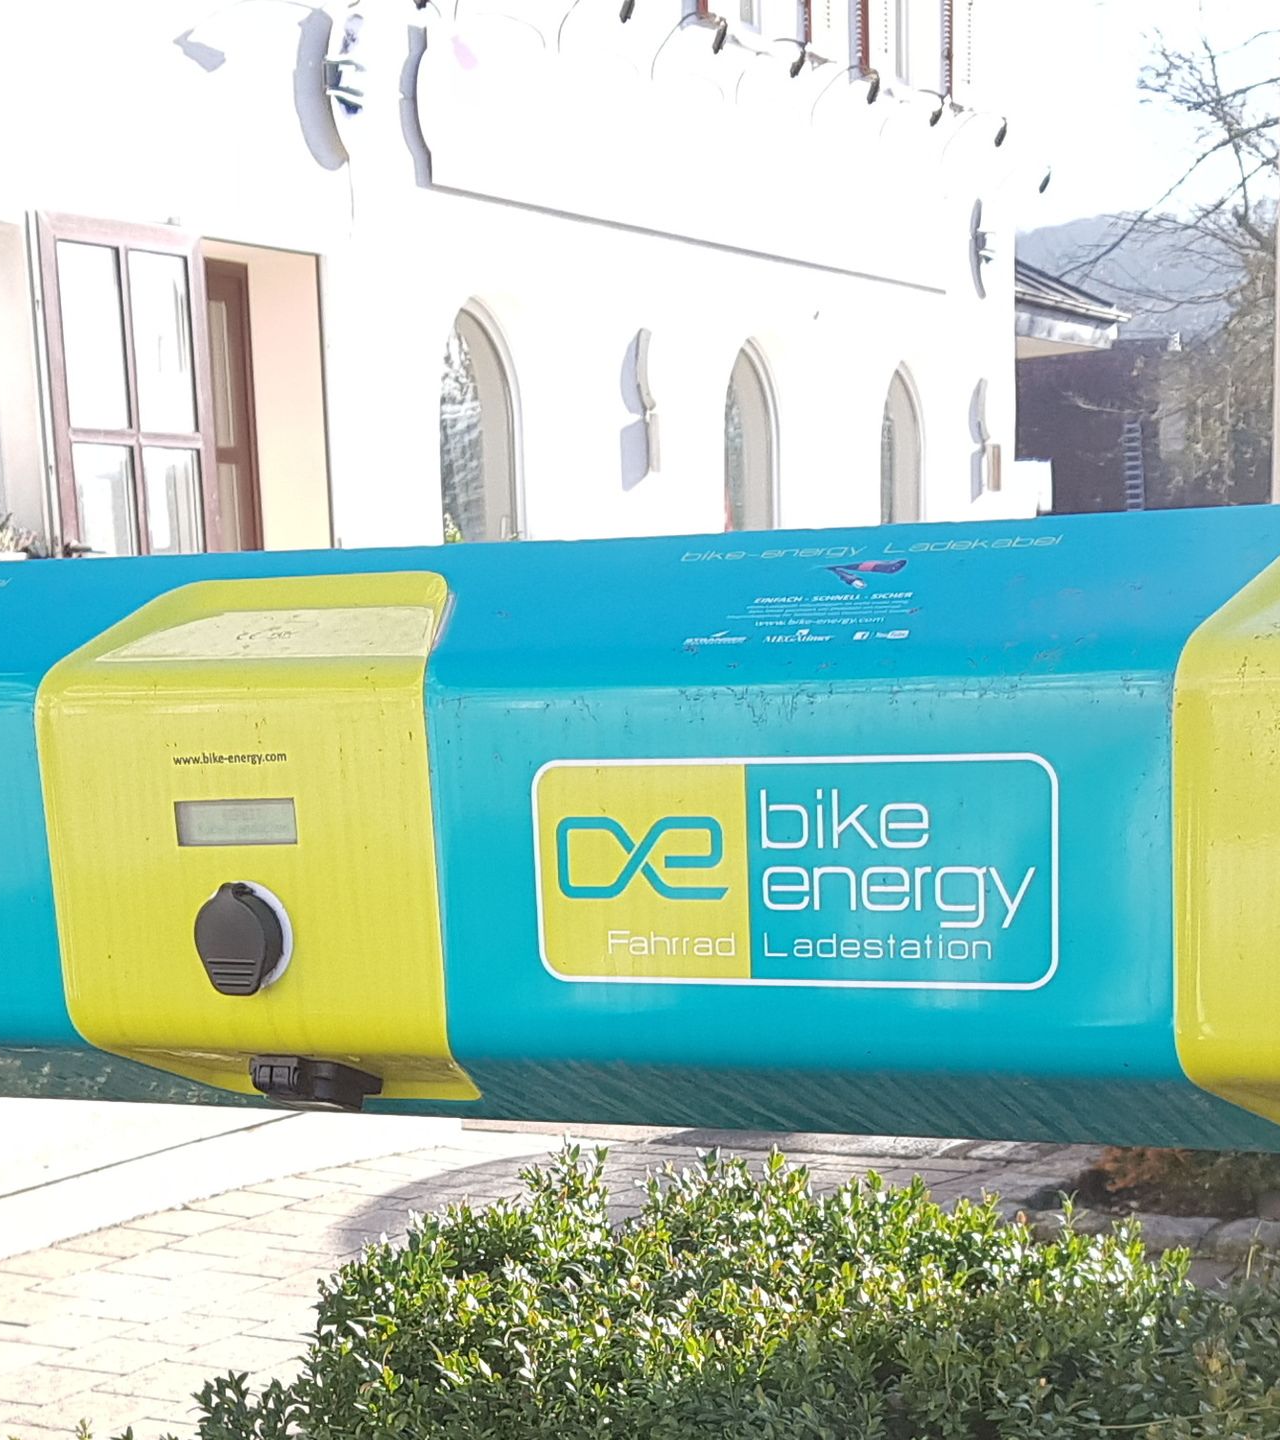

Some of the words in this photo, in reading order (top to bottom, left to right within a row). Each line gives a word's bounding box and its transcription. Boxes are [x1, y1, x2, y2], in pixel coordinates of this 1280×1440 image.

[680, 543, 867, 563] bike-energy
[883, 534, 1063, 555] Ladekabel
[172, 751, 287, 766] www.bike-energy.com
[760, 788, 930, 849] bike
[762, 864, 1036, 929] energy
[607, 930, 736, 958] Fahrrad
[763, 932, 993, 961] Ladestation
